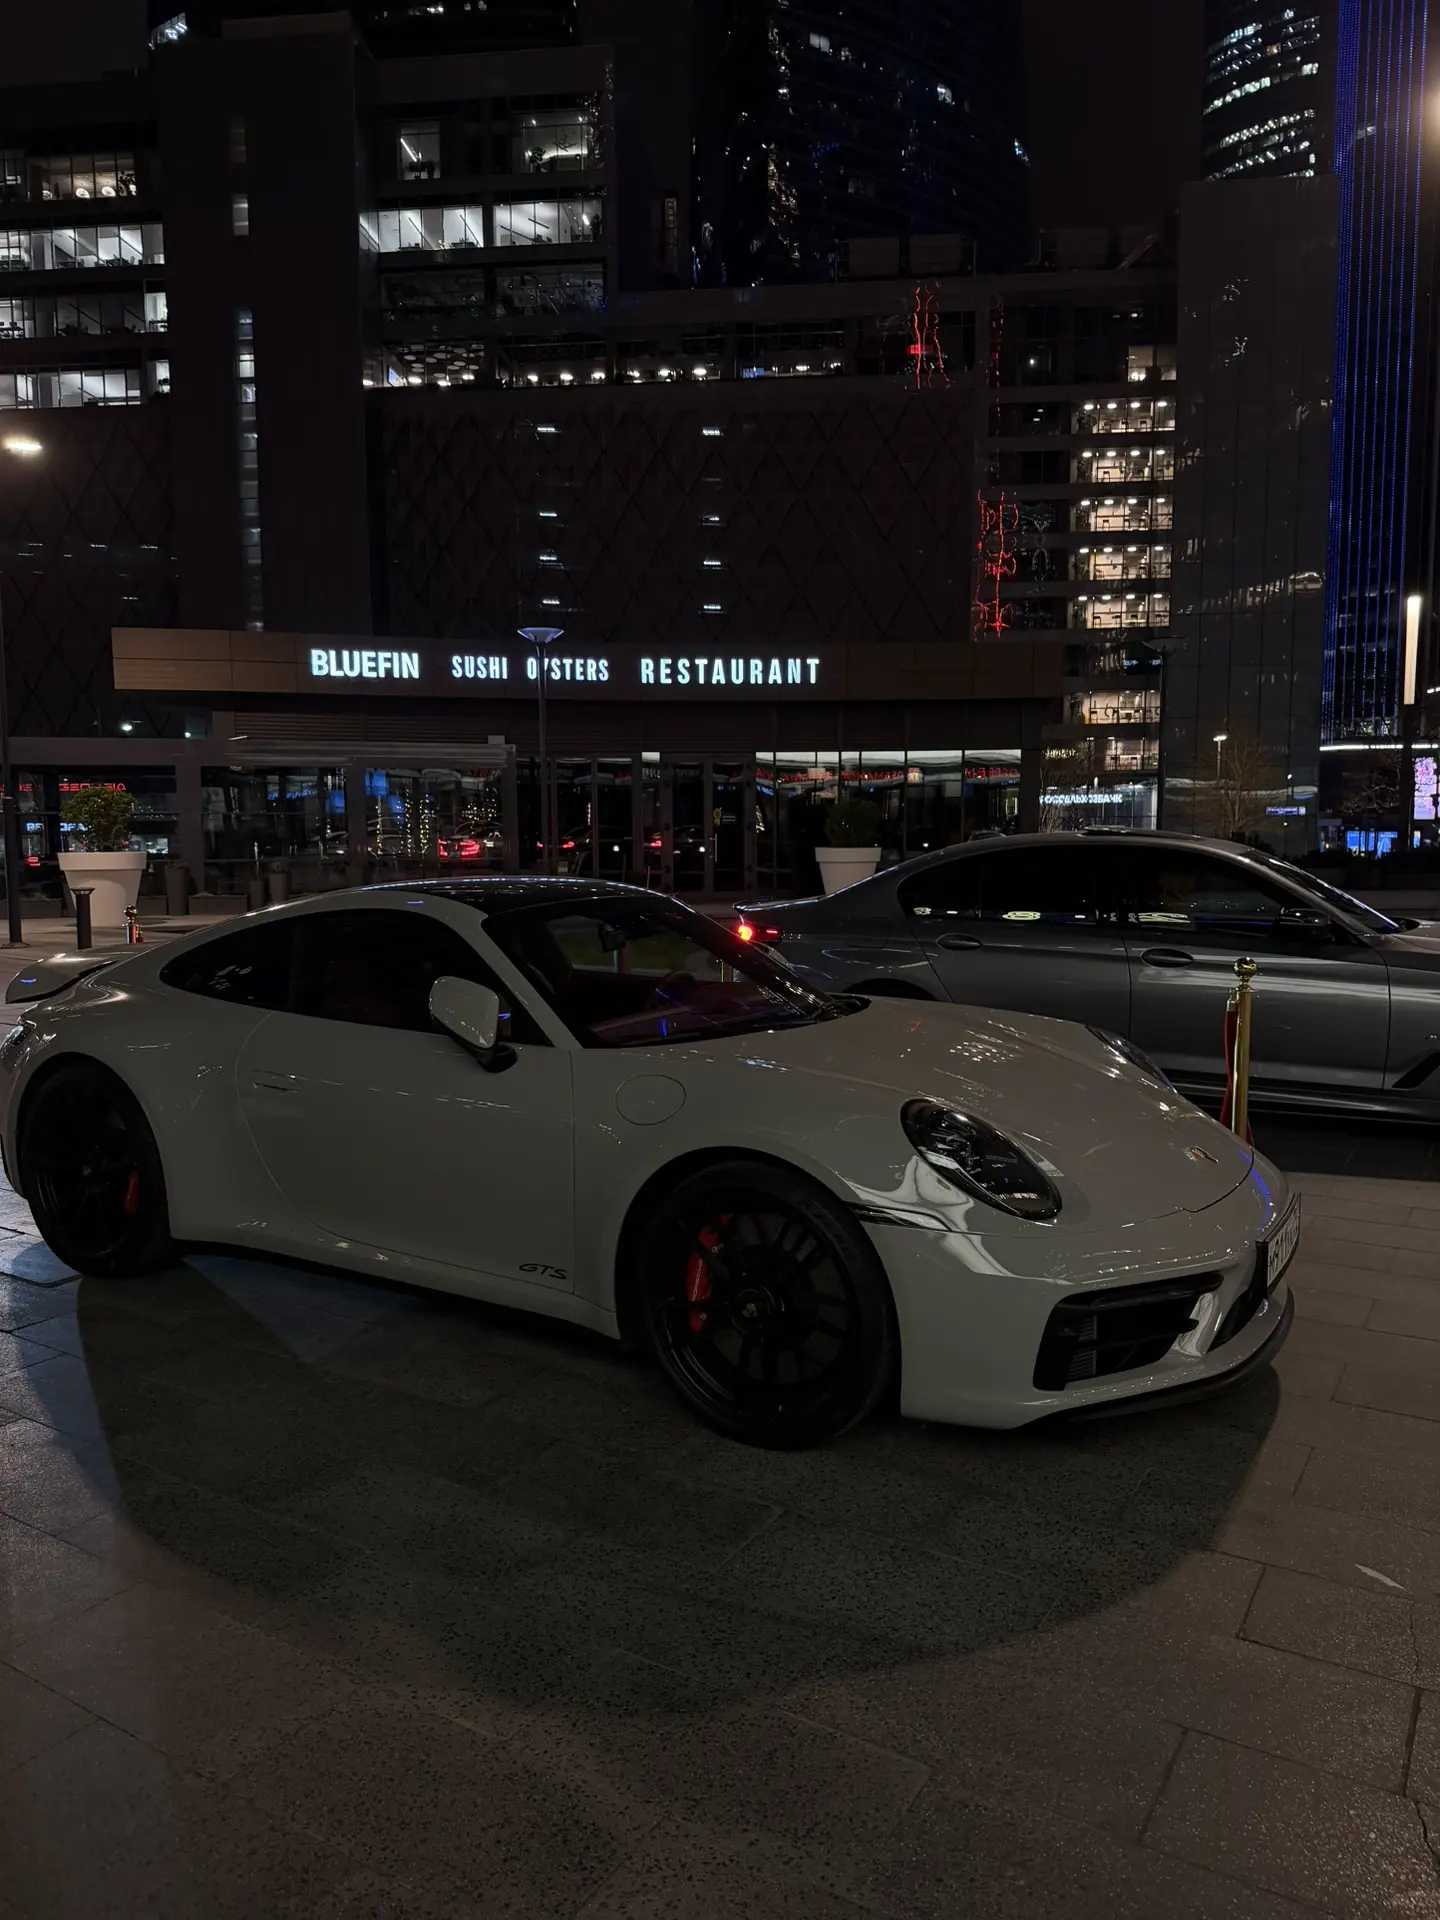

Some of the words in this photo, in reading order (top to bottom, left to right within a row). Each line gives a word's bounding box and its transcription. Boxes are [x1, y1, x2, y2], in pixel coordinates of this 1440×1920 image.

[310, 648, 420, 680] BLUEFIN
[451, 654, 508, 681] SUSHI
[640, 657, 820, 686] RESTAURANT
[518, 1262, 569, 1280] GTS
